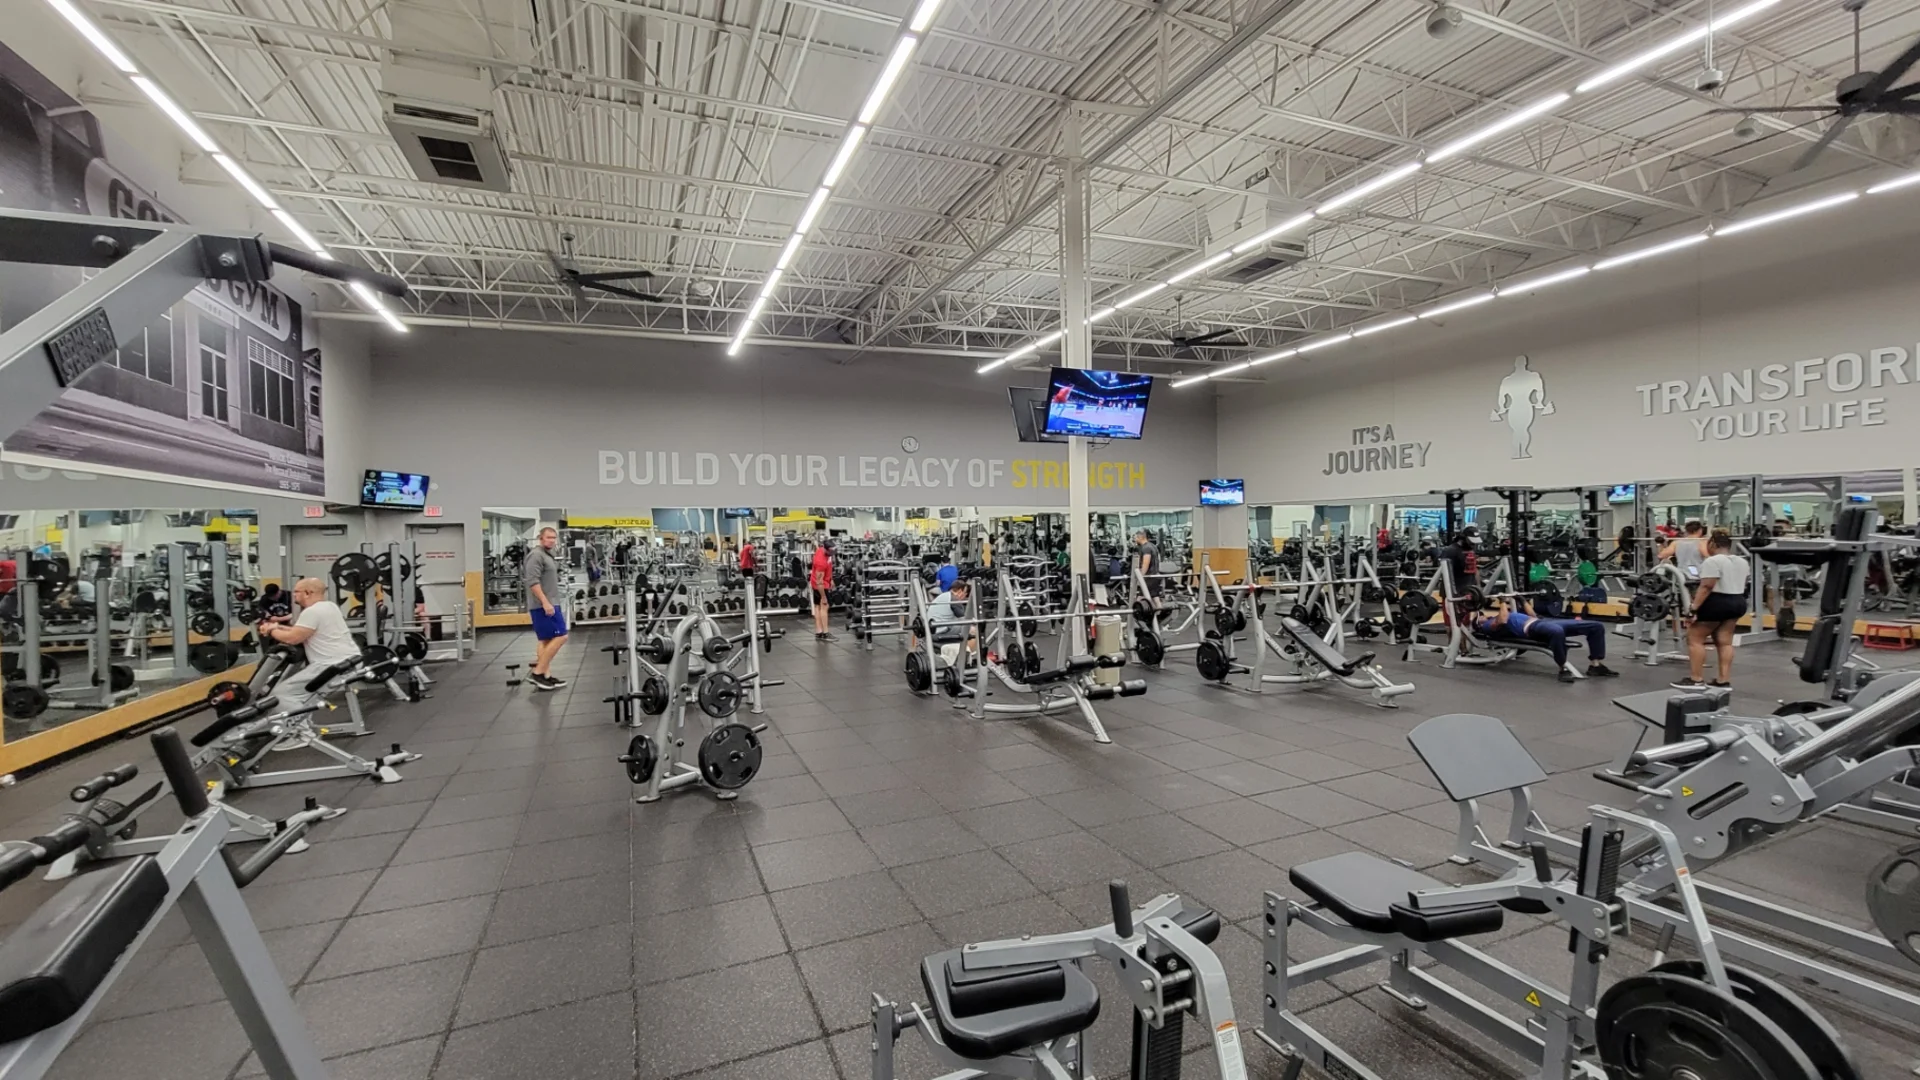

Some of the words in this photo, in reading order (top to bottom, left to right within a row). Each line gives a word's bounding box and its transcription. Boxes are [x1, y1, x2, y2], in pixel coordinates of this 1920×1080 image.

[1636, 342, 1920, 416] TRANSFOR
[1352, 425, 1381, 445] IT'S
[1383, 424, 1395, 441] A
[1690, 409, 1787, 441] YOUR
[1800, 397, 1885, 432] LIFE
[598, 450, 719, 485] BUILD
[729, 453, 828, 486] YOUR
[838, 456, 960, 488] LEGACY
[967, 458, 1004, 488] OF
[1322, 441, 1432, 475] JOURNEY
